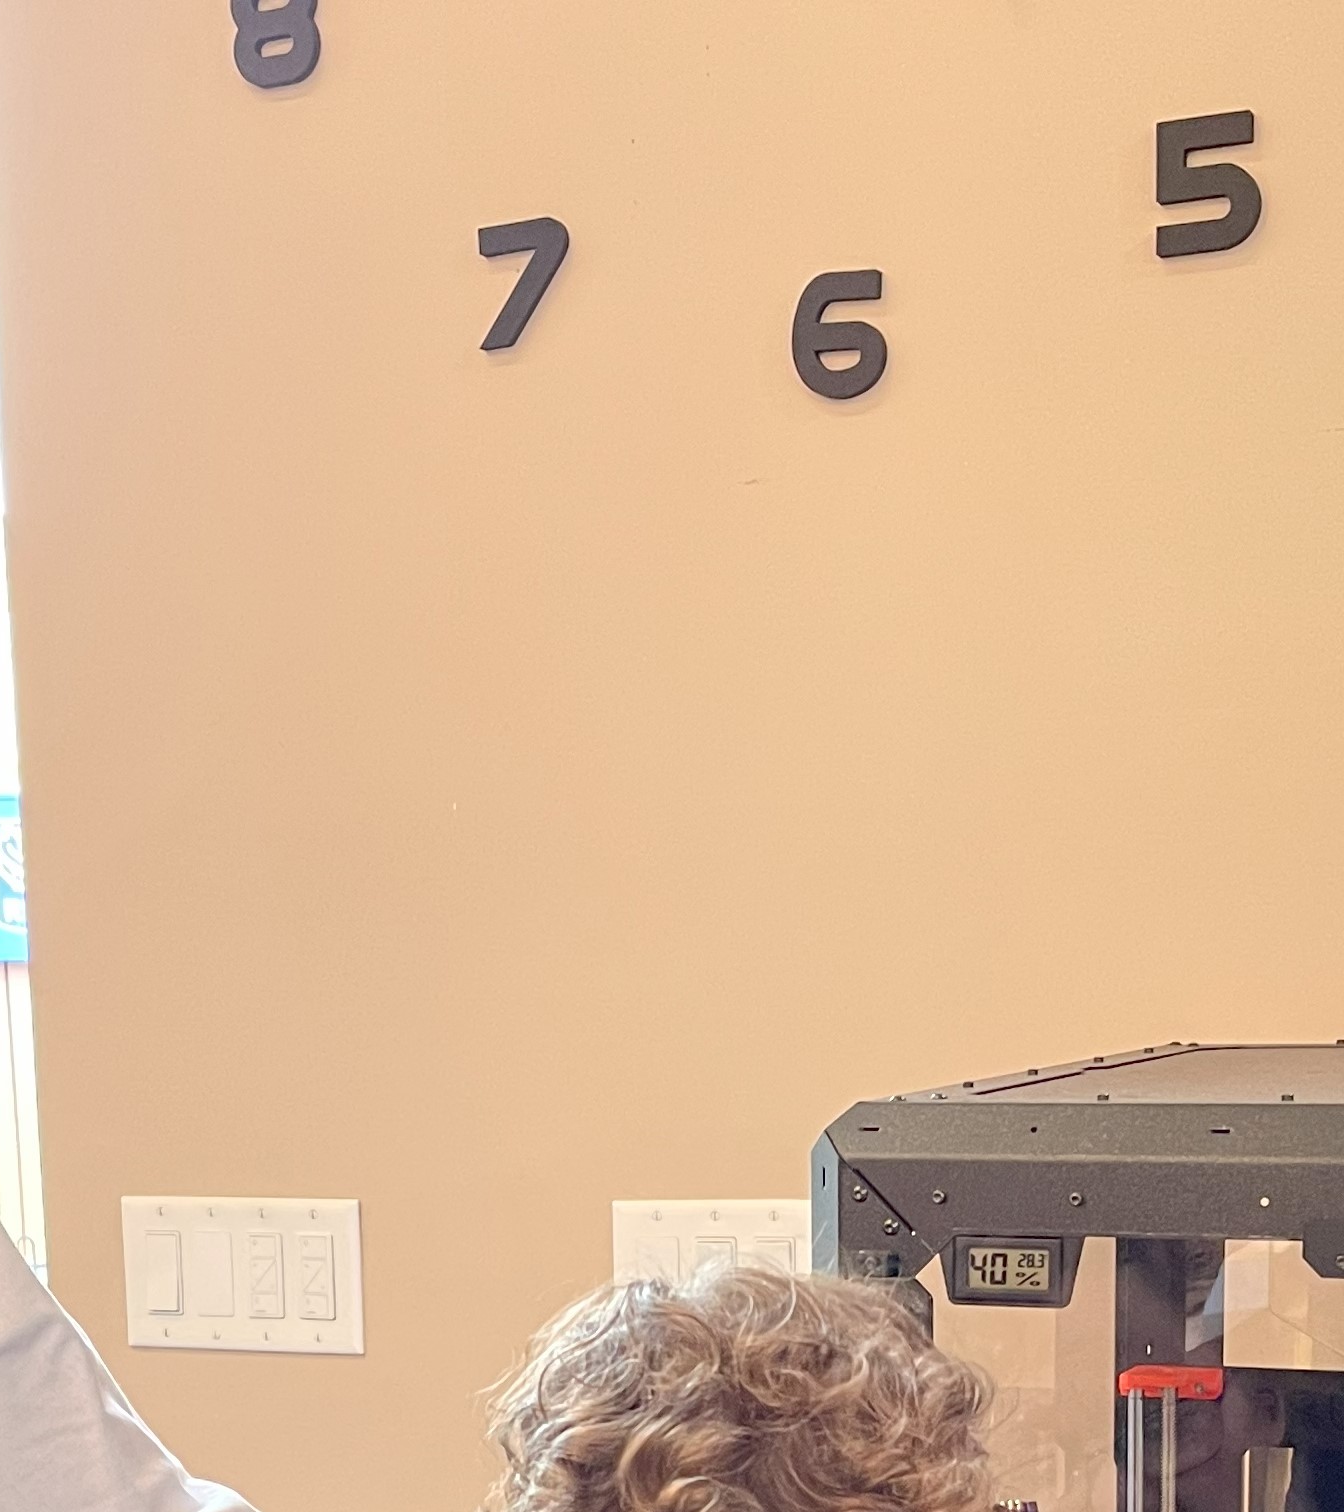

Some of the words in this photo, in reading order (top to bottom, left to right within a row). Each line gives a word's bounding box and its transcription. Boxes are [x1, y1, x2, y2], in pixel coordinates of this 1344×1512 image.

[230, 0, 321, 89] 8
[1155, 110, 1262, 258] 5
[478, 217, 570, 351] 7
[792, 269, 887, 399] 6
[970, 1253, 1008, 1285] 40
